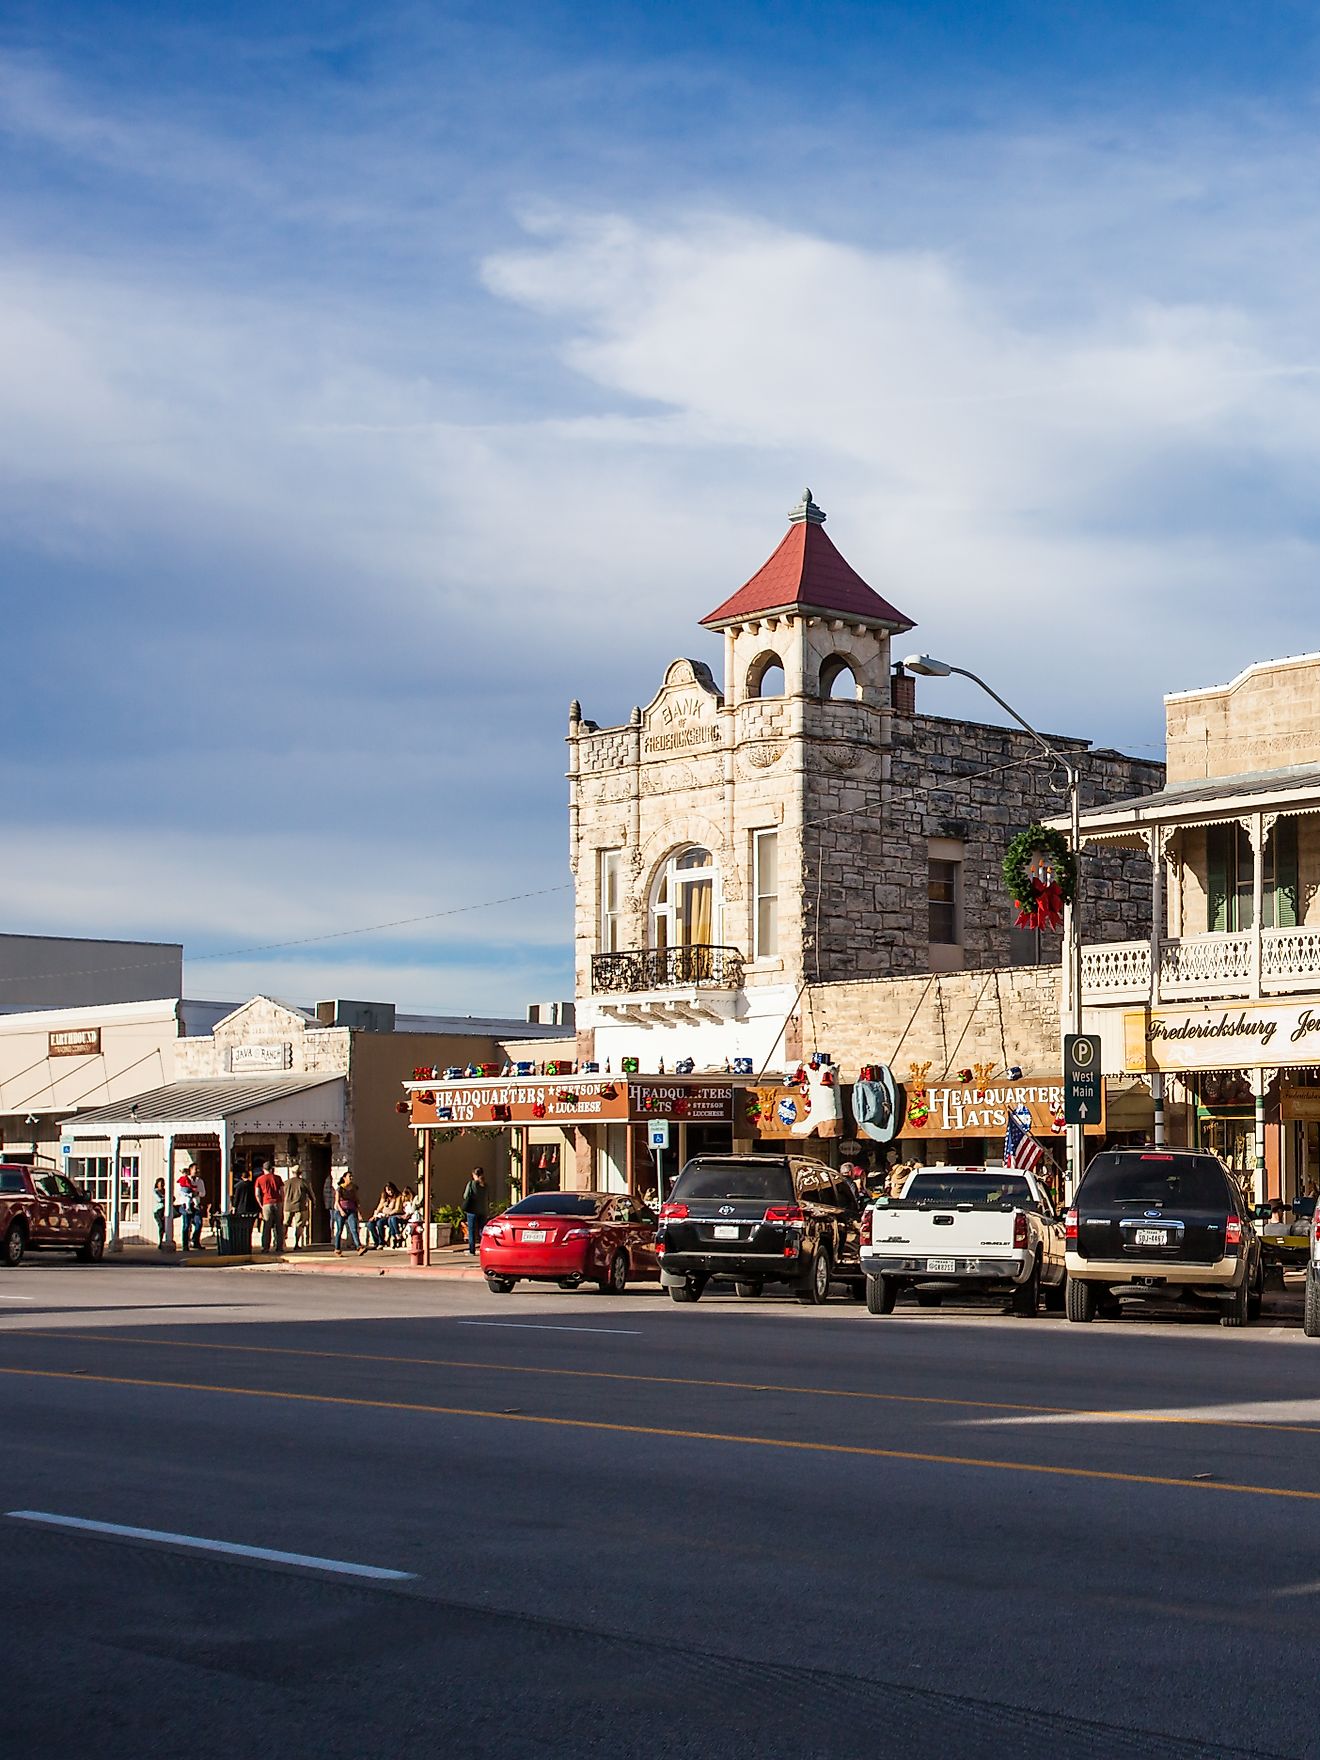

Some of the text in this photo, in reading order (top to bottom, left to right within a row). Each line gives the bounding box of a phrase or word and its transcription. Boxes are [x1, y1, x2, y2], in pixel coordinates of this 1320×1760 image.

[662, 698, 704, 726] BANK
[1145, 1012, 1278, 1045] Fredericksburg
[235, 1048, 253, 1061] JAVA
[1072, 1071, 1094, 1082] West
[435, 1088, 545, 1108] HEADQUARTERS
[629, 1085, 732, 1100] HEADQUTERS
[1072, 1085, 1094, 1097] Main
[439, 1105, 474, 1121] ATS
[556, 1101, 602, 1113] LUCCHESE
[636, 1099, 672, 1112] HTS
[941, 1105, 1006, 1130] HATS
